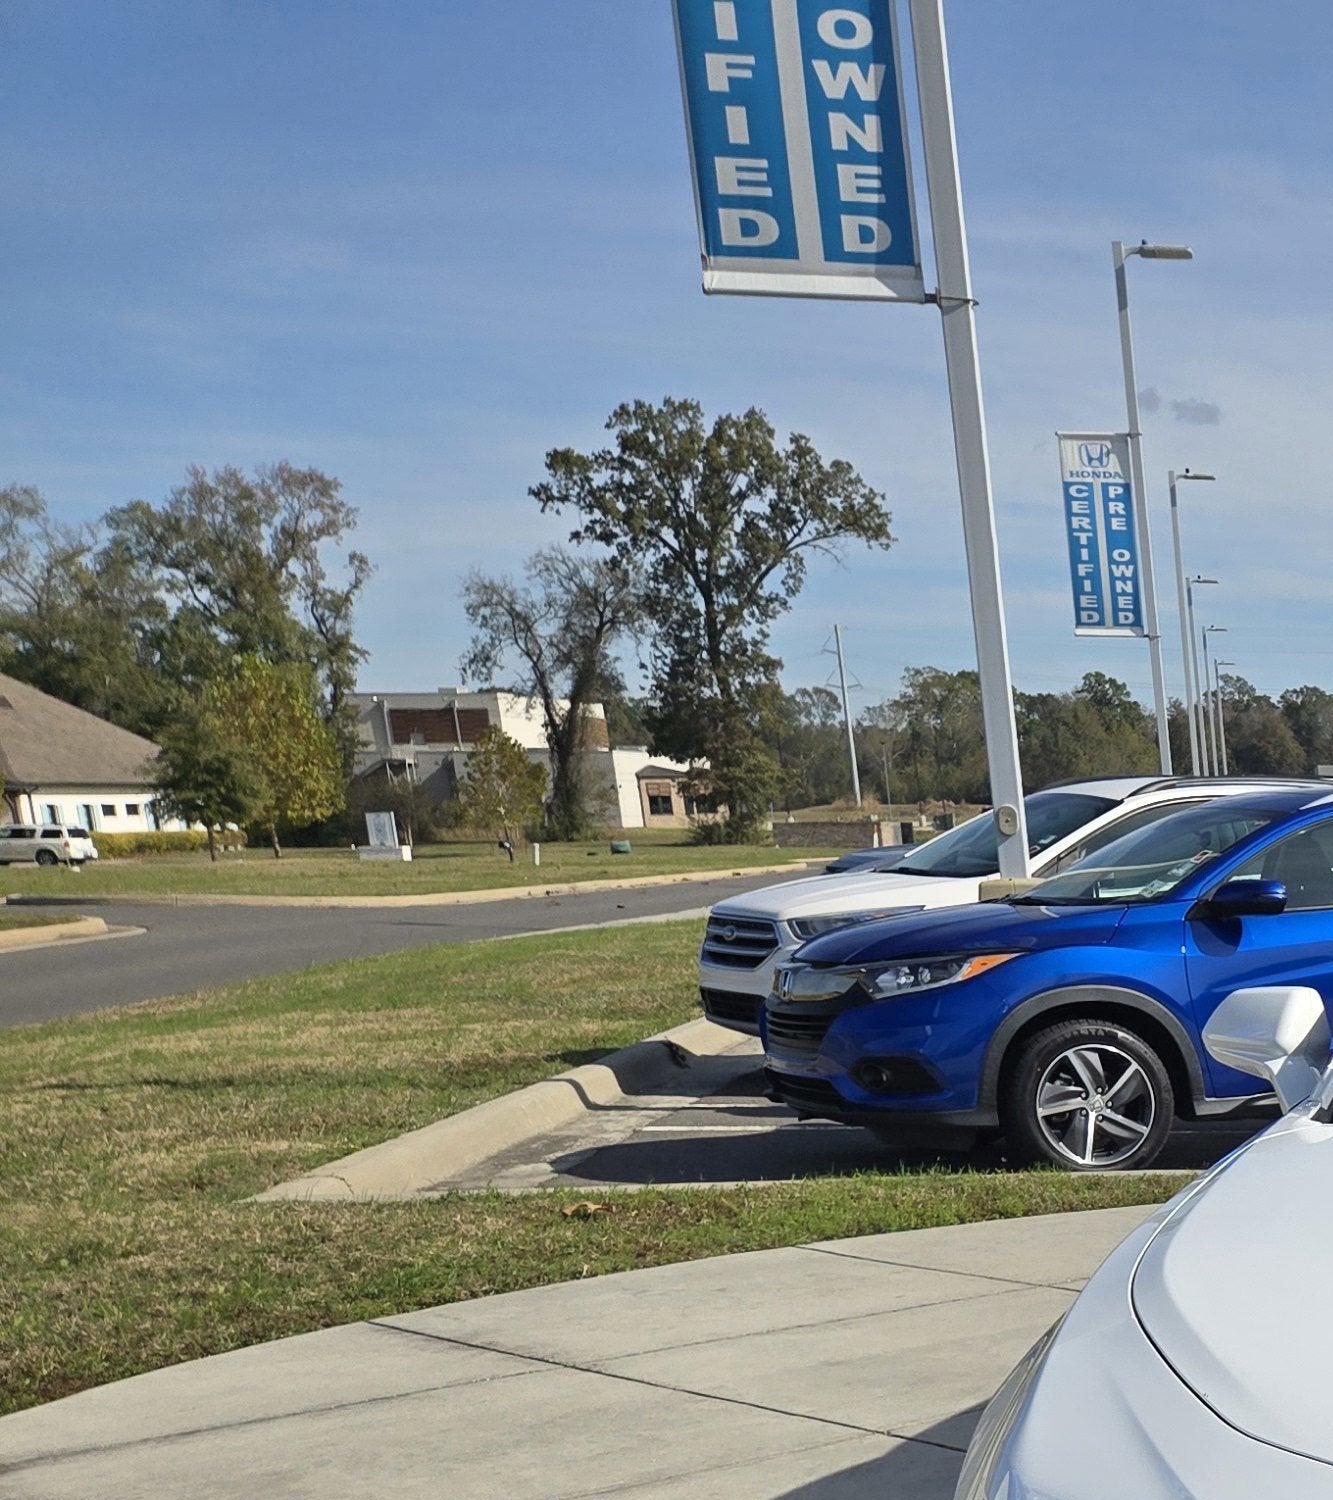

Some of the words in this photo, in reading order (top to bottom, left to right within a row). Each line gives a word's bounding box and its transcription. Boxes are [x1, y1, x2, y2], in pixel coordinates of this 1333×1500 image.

[811, 8, 892, 253] OWNED
[1069, 469, 1124, 480] HONDA
[1107, 485, 1127, 531] PRE
[1068, 484, 1100, 625] CERTIFIED
[1110, 548, 1136, 625] OWNED
